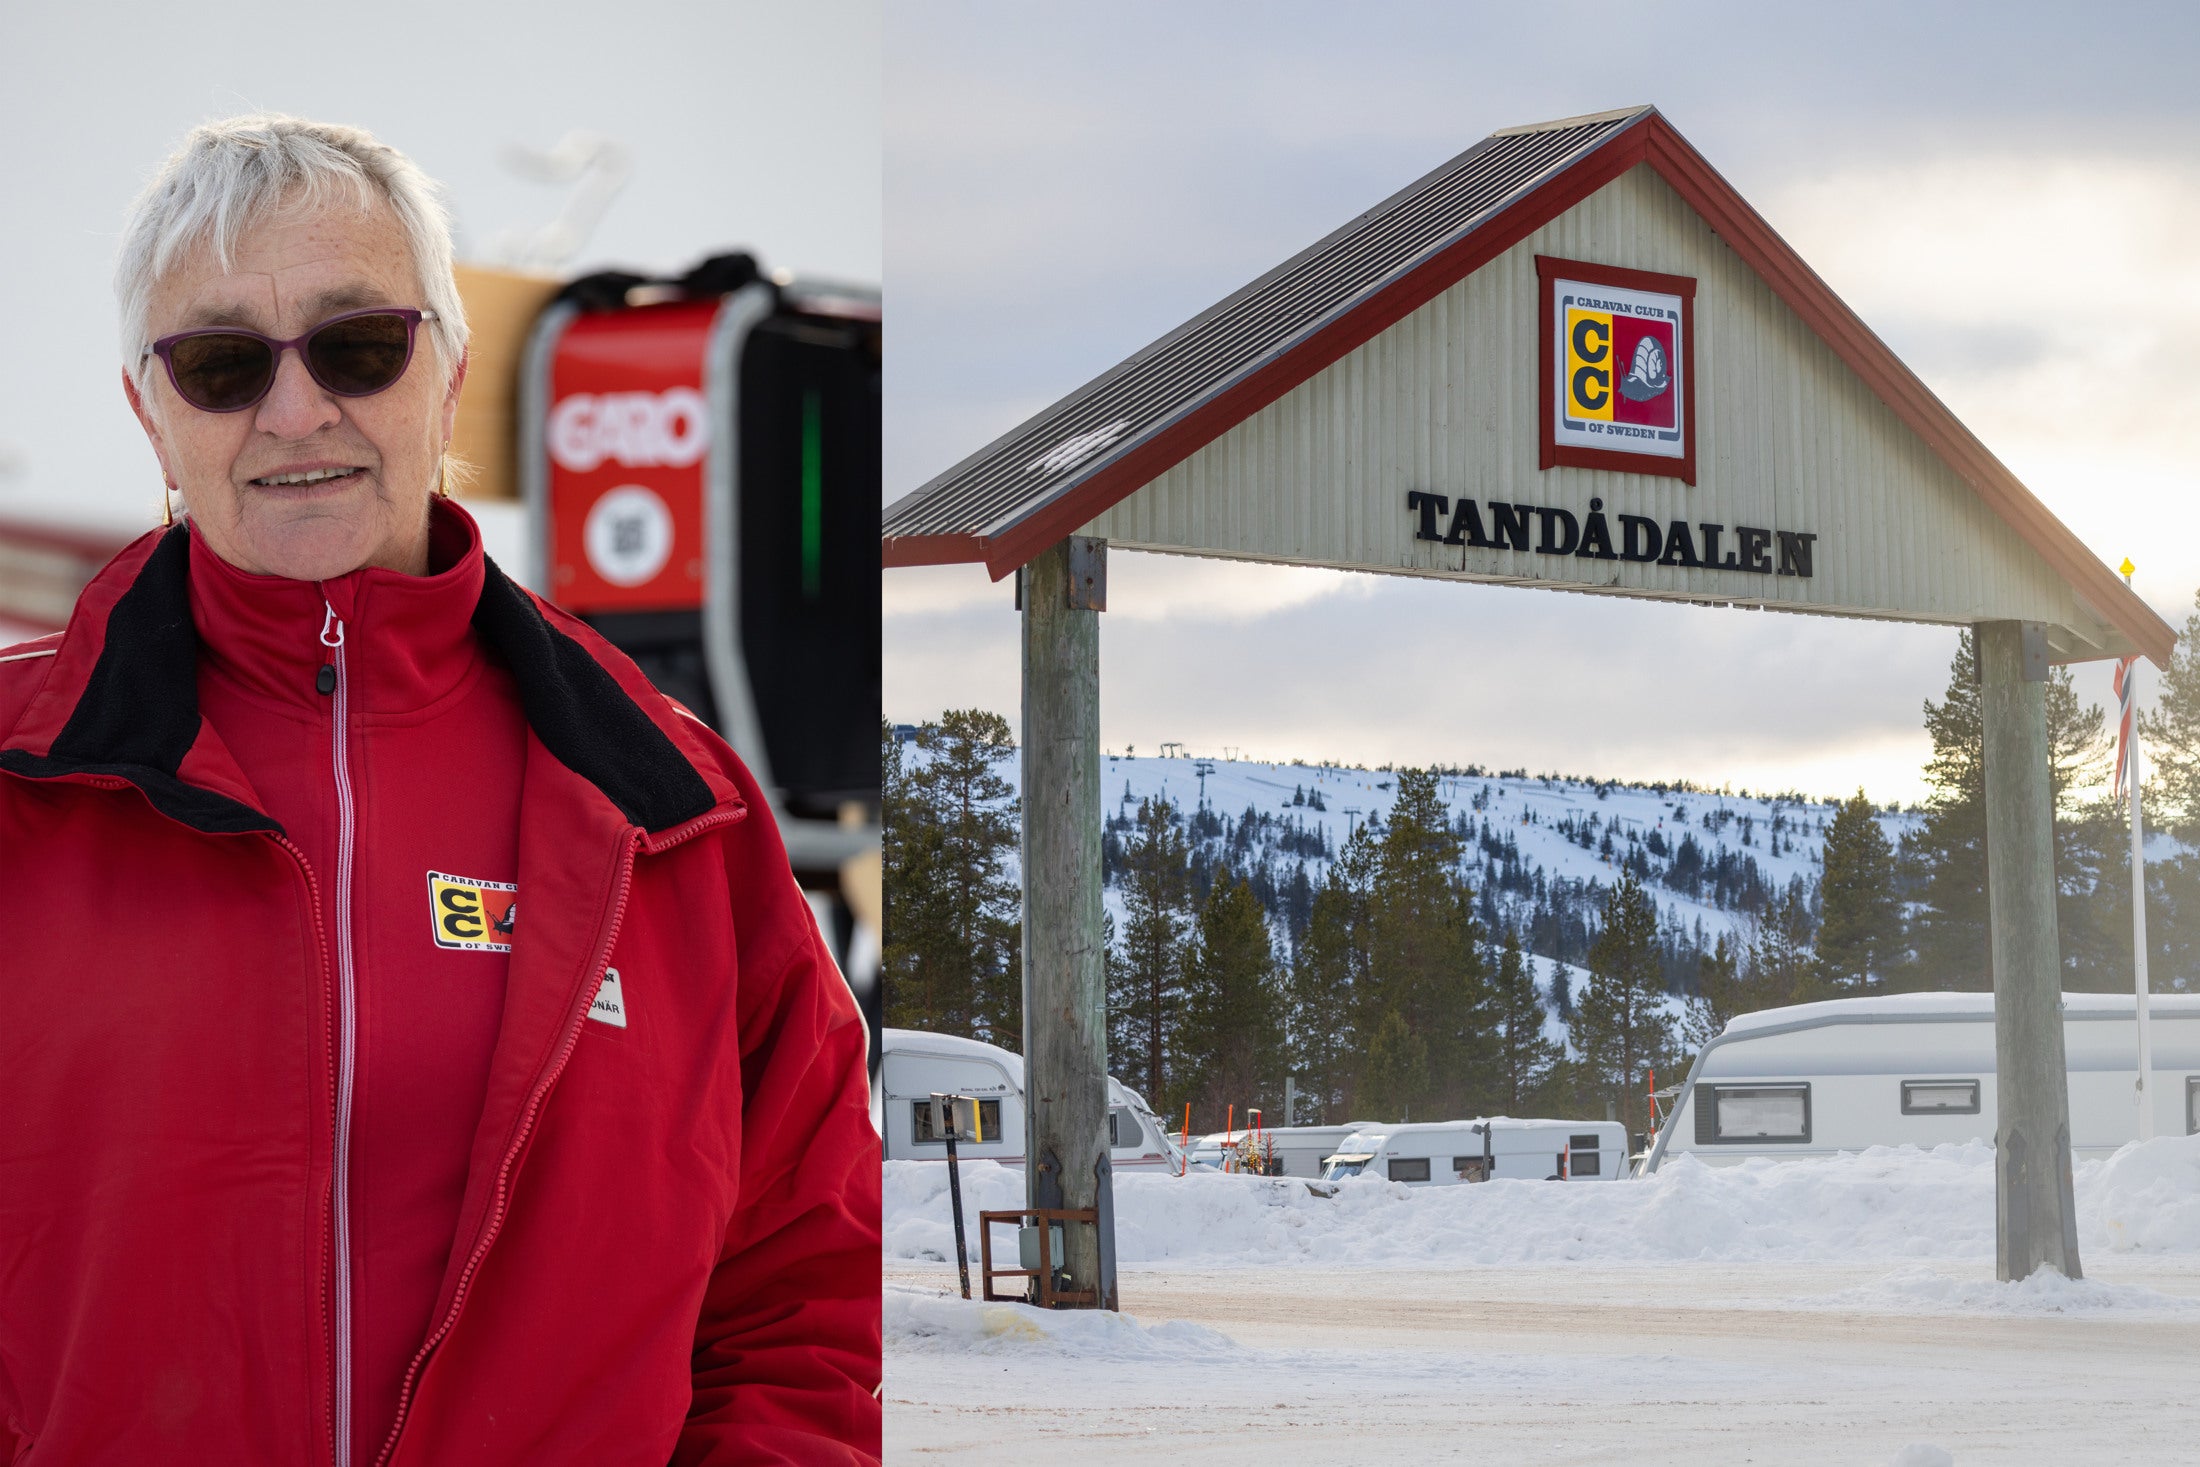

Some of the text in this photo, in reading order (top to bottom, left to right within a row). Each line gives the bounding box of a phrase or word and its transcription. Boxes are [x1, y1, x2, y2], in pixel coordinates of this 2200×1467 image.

[1577, 296, 1664, 318] CARAVAN CLUB
[1588, 422, 1656, 440] OF SWEDEN
[1408, 490, 1817, 578] TANDÅDALEN
[442, 874, 500, 889] CARAVAN
[486, 943, 511, 951] SWE
[591, 999, 620, 1014] ONÄR
